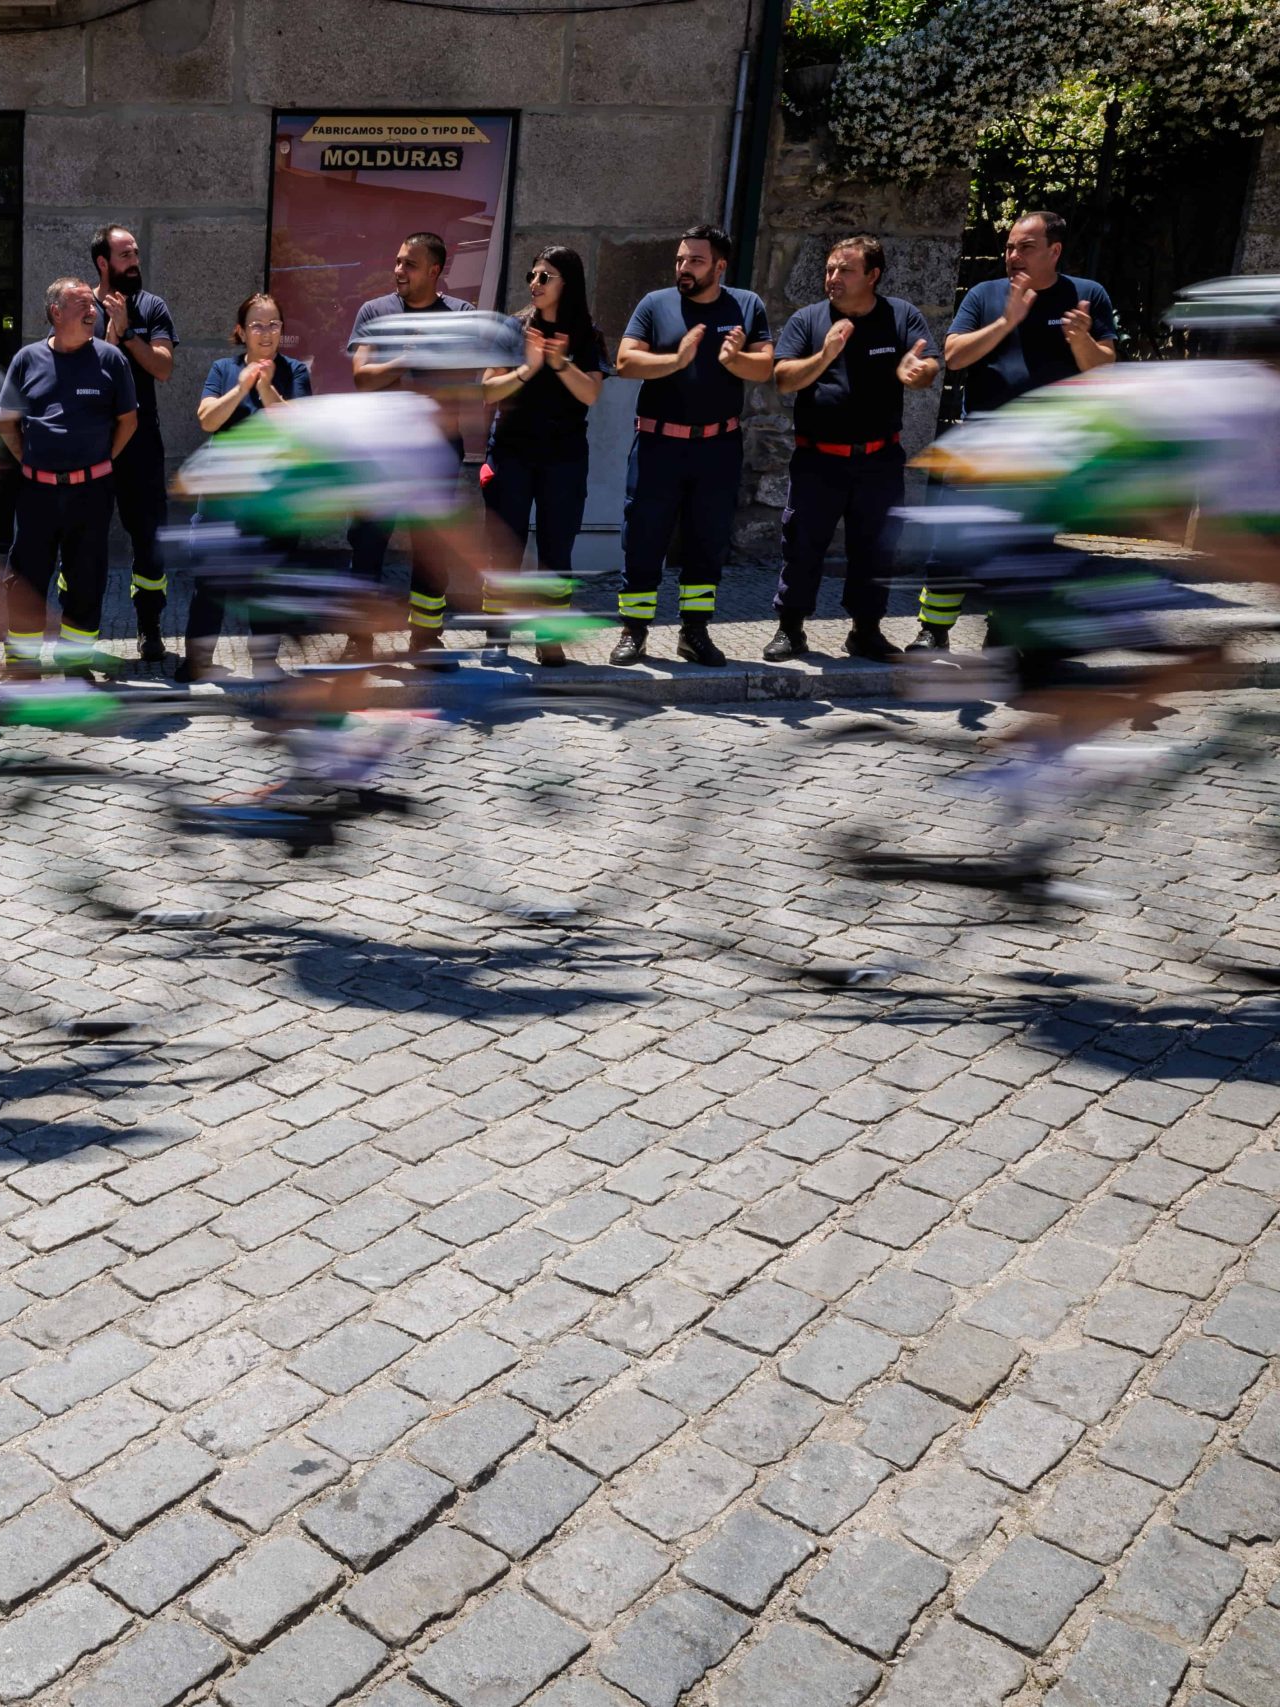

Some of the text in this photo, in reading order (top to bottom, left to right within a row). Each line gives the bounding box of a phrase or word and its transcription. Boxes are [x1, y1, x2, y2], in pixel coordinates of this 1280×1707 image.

[312, 126, 476, 135] FABRICAMOS TODO O TIPO DE
[323, 149, 458, 167] MOLDURAS
